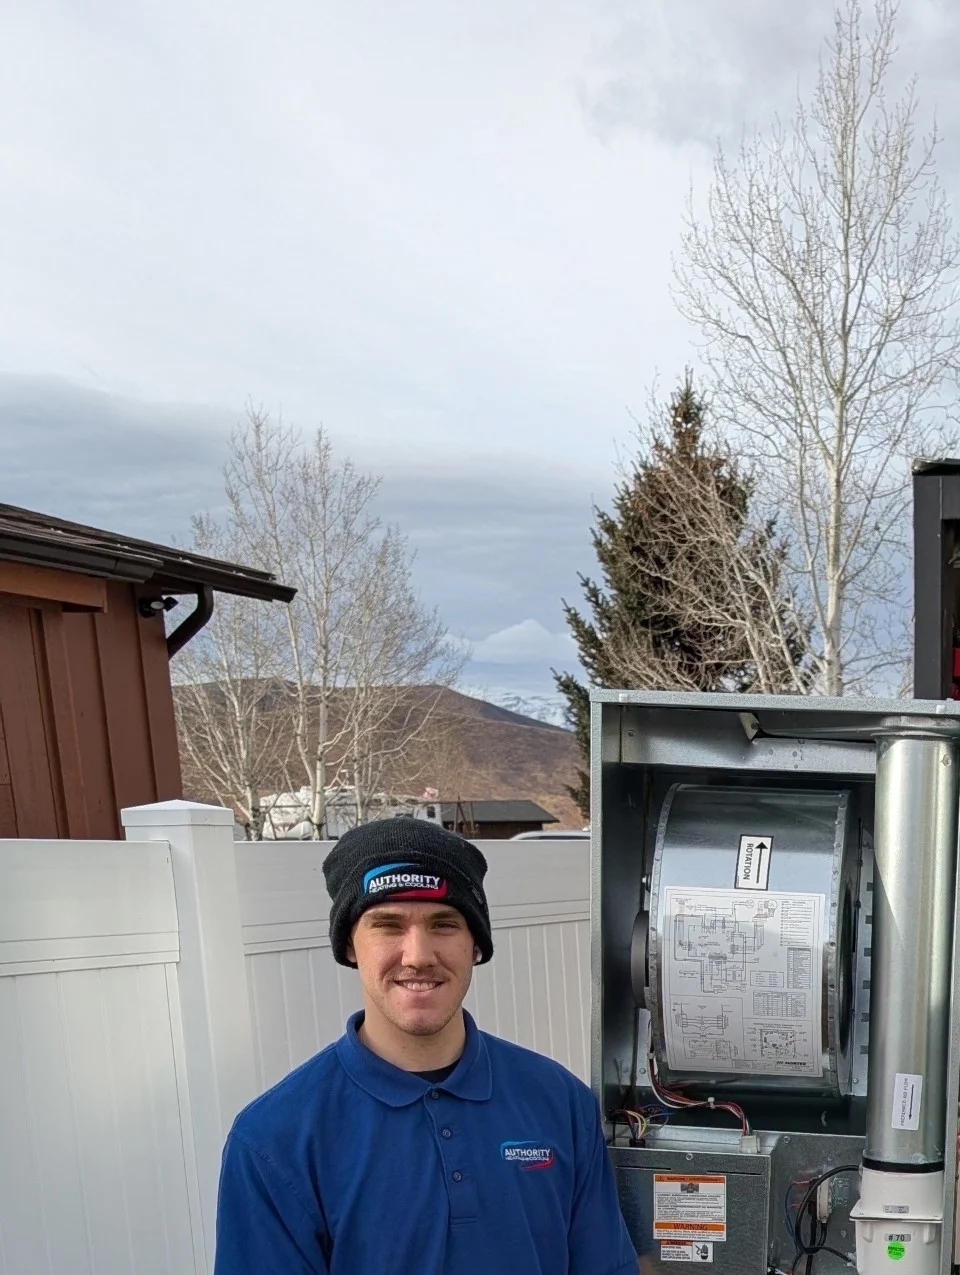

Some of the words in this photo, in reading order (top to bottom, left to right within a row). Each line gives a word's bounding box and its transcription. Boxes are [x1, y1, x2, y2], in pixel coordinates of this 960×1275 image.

[743, 843, 754, 880] ROTATION
[368, 874, 440, 890] AUTHORITY
[368, 882, 396, 894] HEATING
[504, 1148, 550, 1157] AUTHORITY
